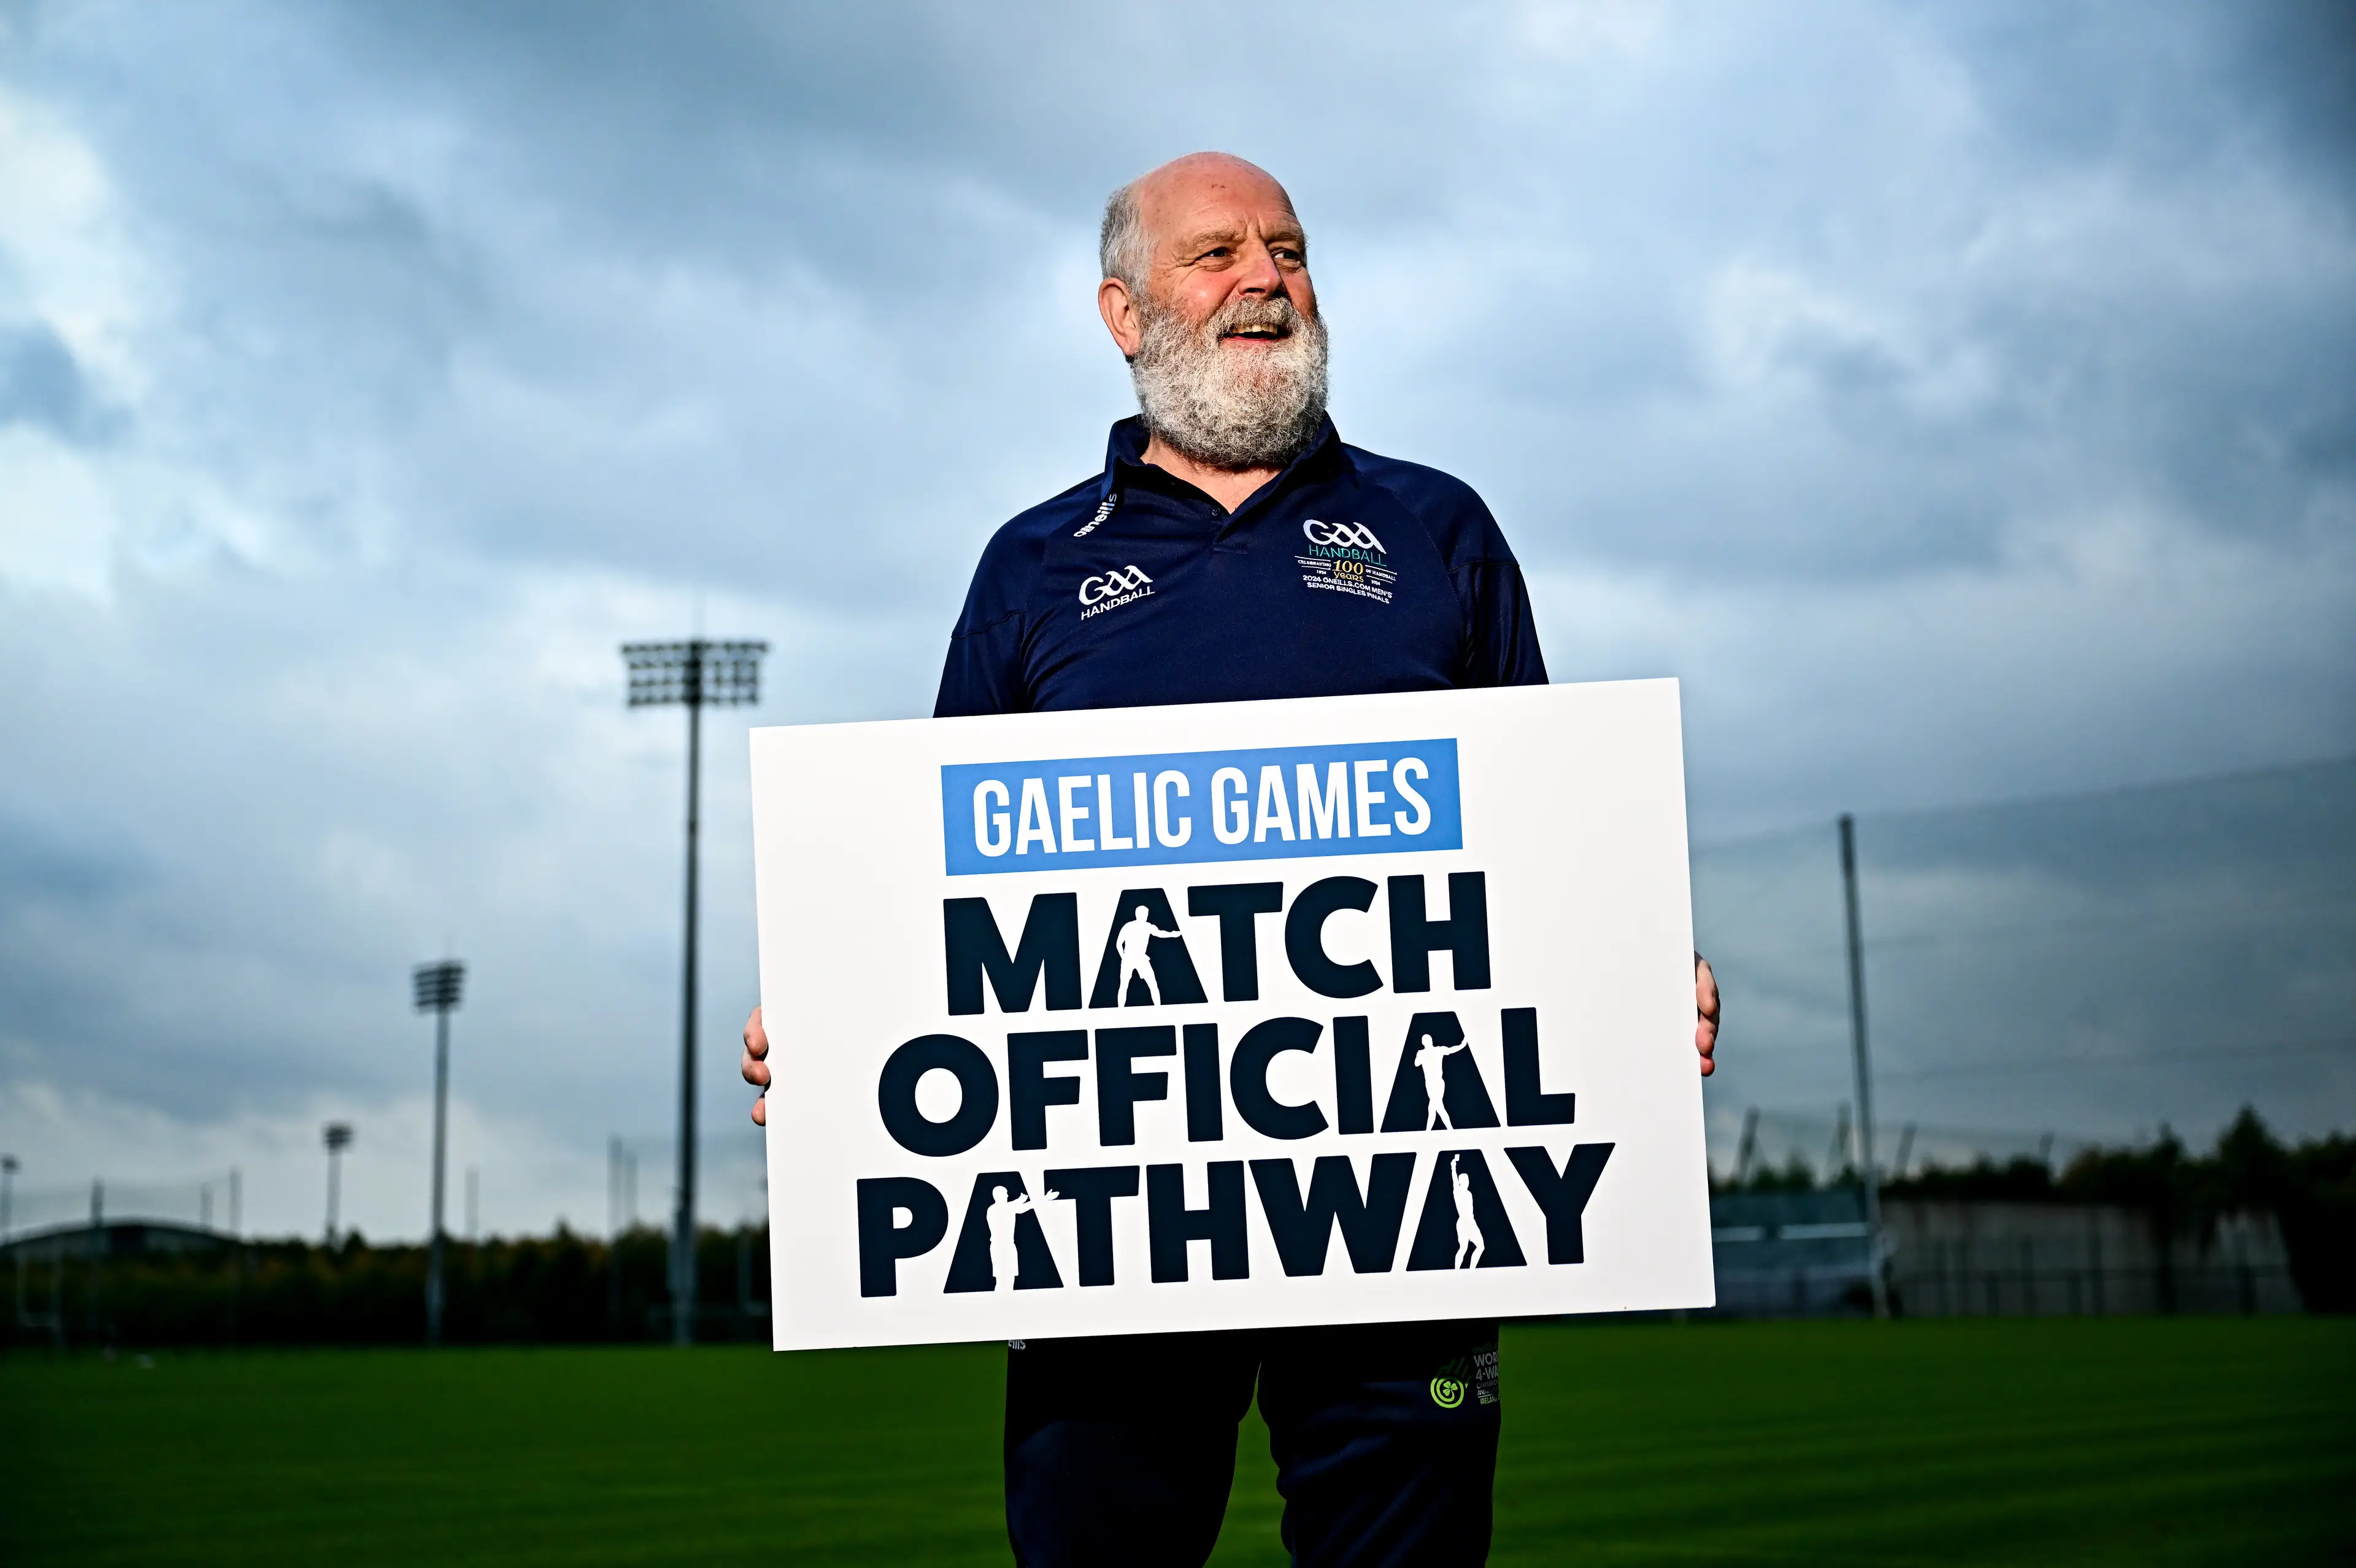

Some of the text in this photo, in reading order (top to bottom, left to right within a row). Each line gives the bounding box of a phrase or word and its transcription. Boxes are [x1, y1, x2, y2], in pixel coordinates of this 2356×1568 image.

[1309, 544, 1387, 567] HANDBALL
[1333, 559, 1364, 575] 100
[1079, 565, 1153, 605] GAA
[1372, 570, 1396, 582] HANDBALL
[1081, 586, 1155, 621] HANDBALL
[1307, 582, 1390, 604] SENIOR SINGLES FINALS
[1371, 586, 1393, 599] MEN'S
[973, 756, 1432, 857] GAELIC GAMES
[943, 870, 1492, 1017] MATCH
[878, 1007, 1576, 1158] OFFICIAL
[857, 1142, 1616, 1298] PATHWAY
[1474, 1351, 1498, 1367] WOR
[1476, 1365, 1498, 1381] 4-WA
